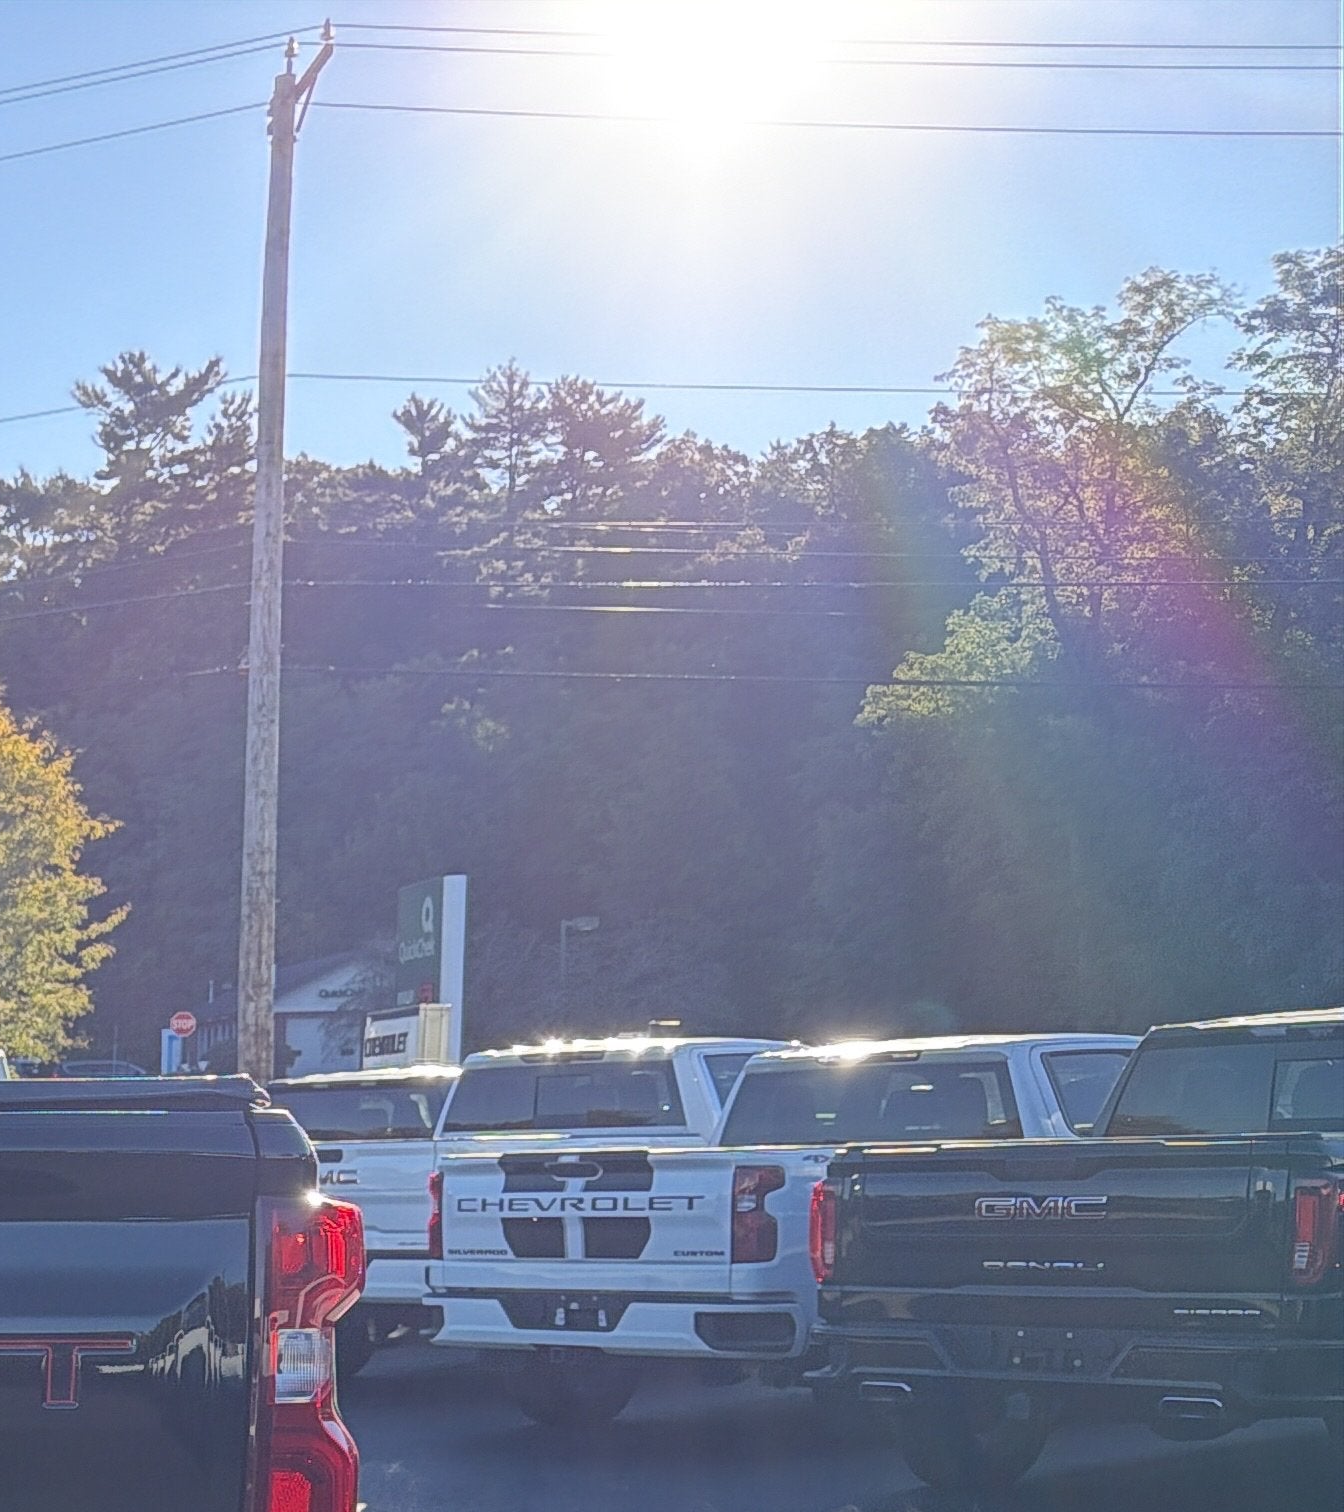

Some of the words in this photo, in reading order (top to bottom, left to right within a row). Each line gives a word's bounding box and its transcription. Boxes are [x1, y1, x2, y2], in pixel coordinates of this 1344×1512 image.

[422, 896, 433, 932] Q
[172, 1018, 194, 1030] STOP
[319, 1169, 359, 1185] MC
[457, 1195, 705, 1213] CHEVROLET
[974, 1195, 1108, 1220] GMC
